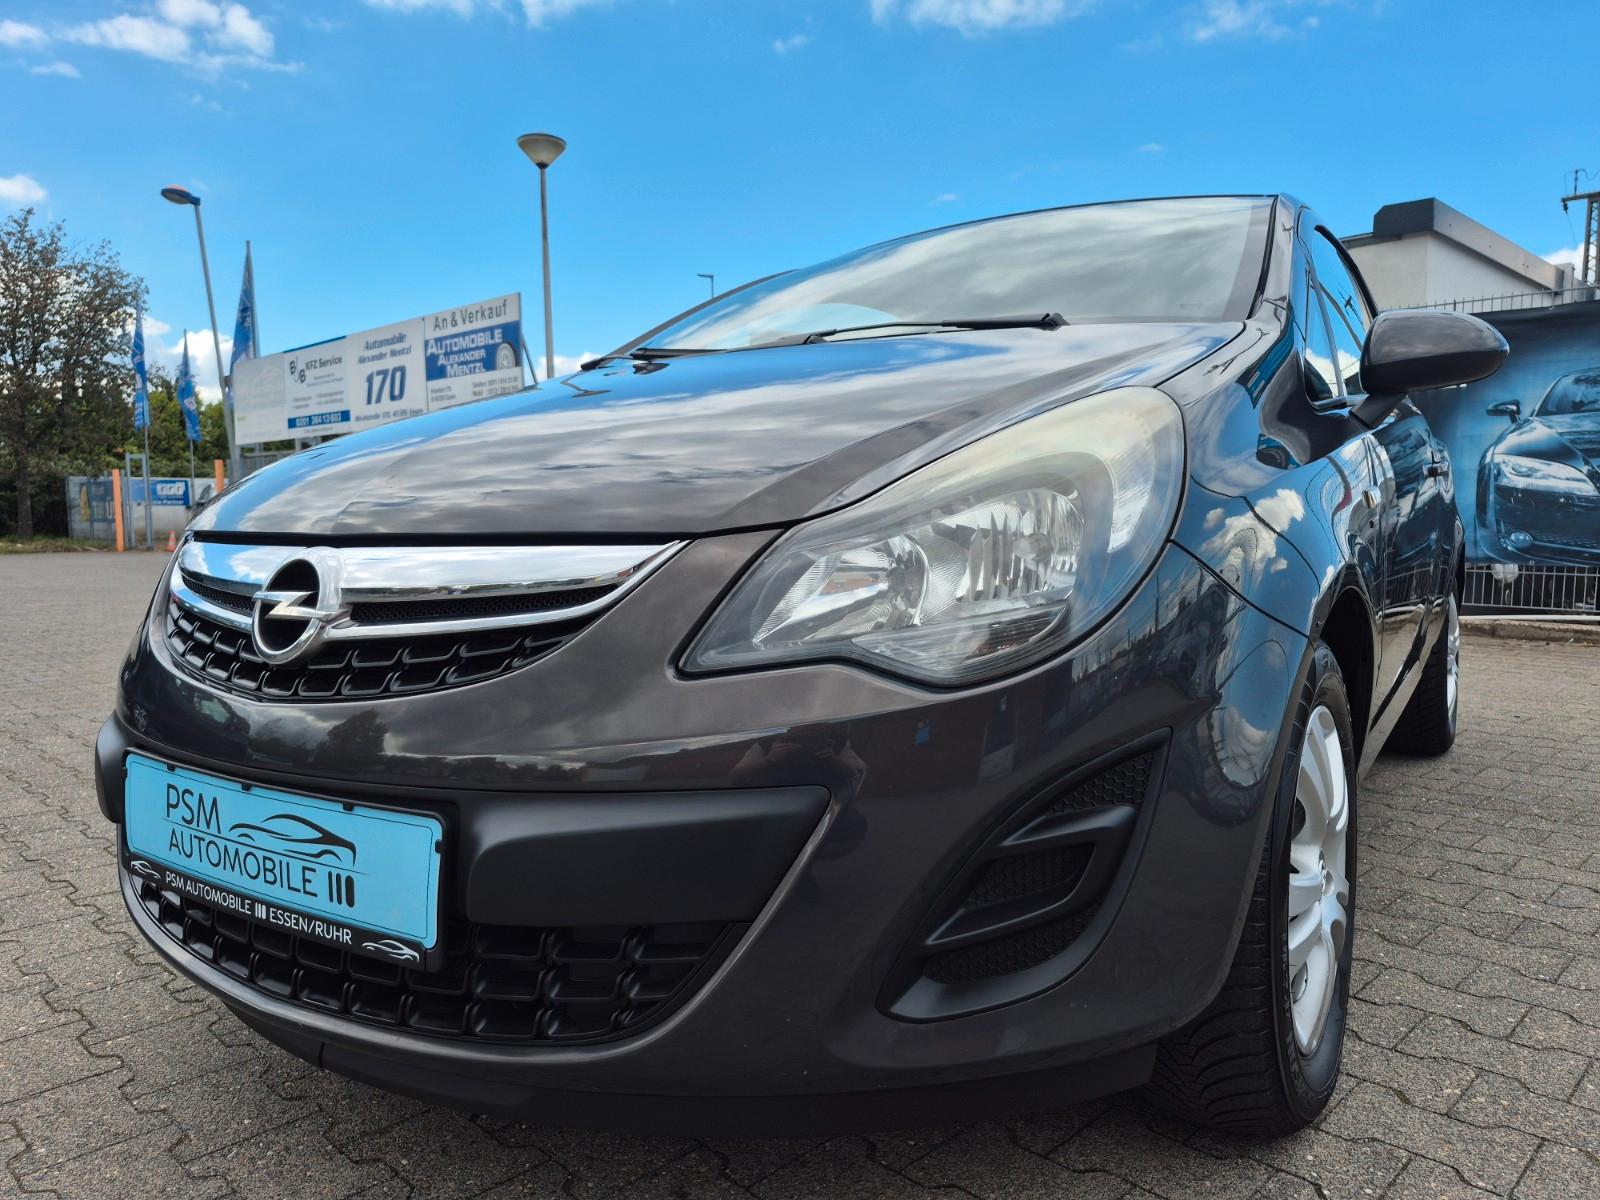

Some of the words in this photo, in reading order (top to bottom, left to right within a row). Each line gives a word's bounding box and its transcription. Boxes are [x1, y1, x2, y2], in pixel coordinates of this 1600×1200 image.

[433, 316, 448, 332] An
[450, 311, 458, 328] &
[460, 299, 508, 325] Verkauf
[364, 333, 407, 351] Automobile
[426, 329, 503, 357] AUTOMOBILE
[438, 349, 486, 366] ALEXANDER
[305, 358, 318, 370] KFZ
[319, 355, 342, 368] Service
[366, 365, 407, 405] 170
[166, 783, 221, 834] PSM
[169, 827, 318, 898] AUTOMOBILE
[166, 871, 184, 890] PSM
[186, 883, 252, 915] AUTOMOBILE
[269, 908, 352, 945] ESSEN/RUHR
